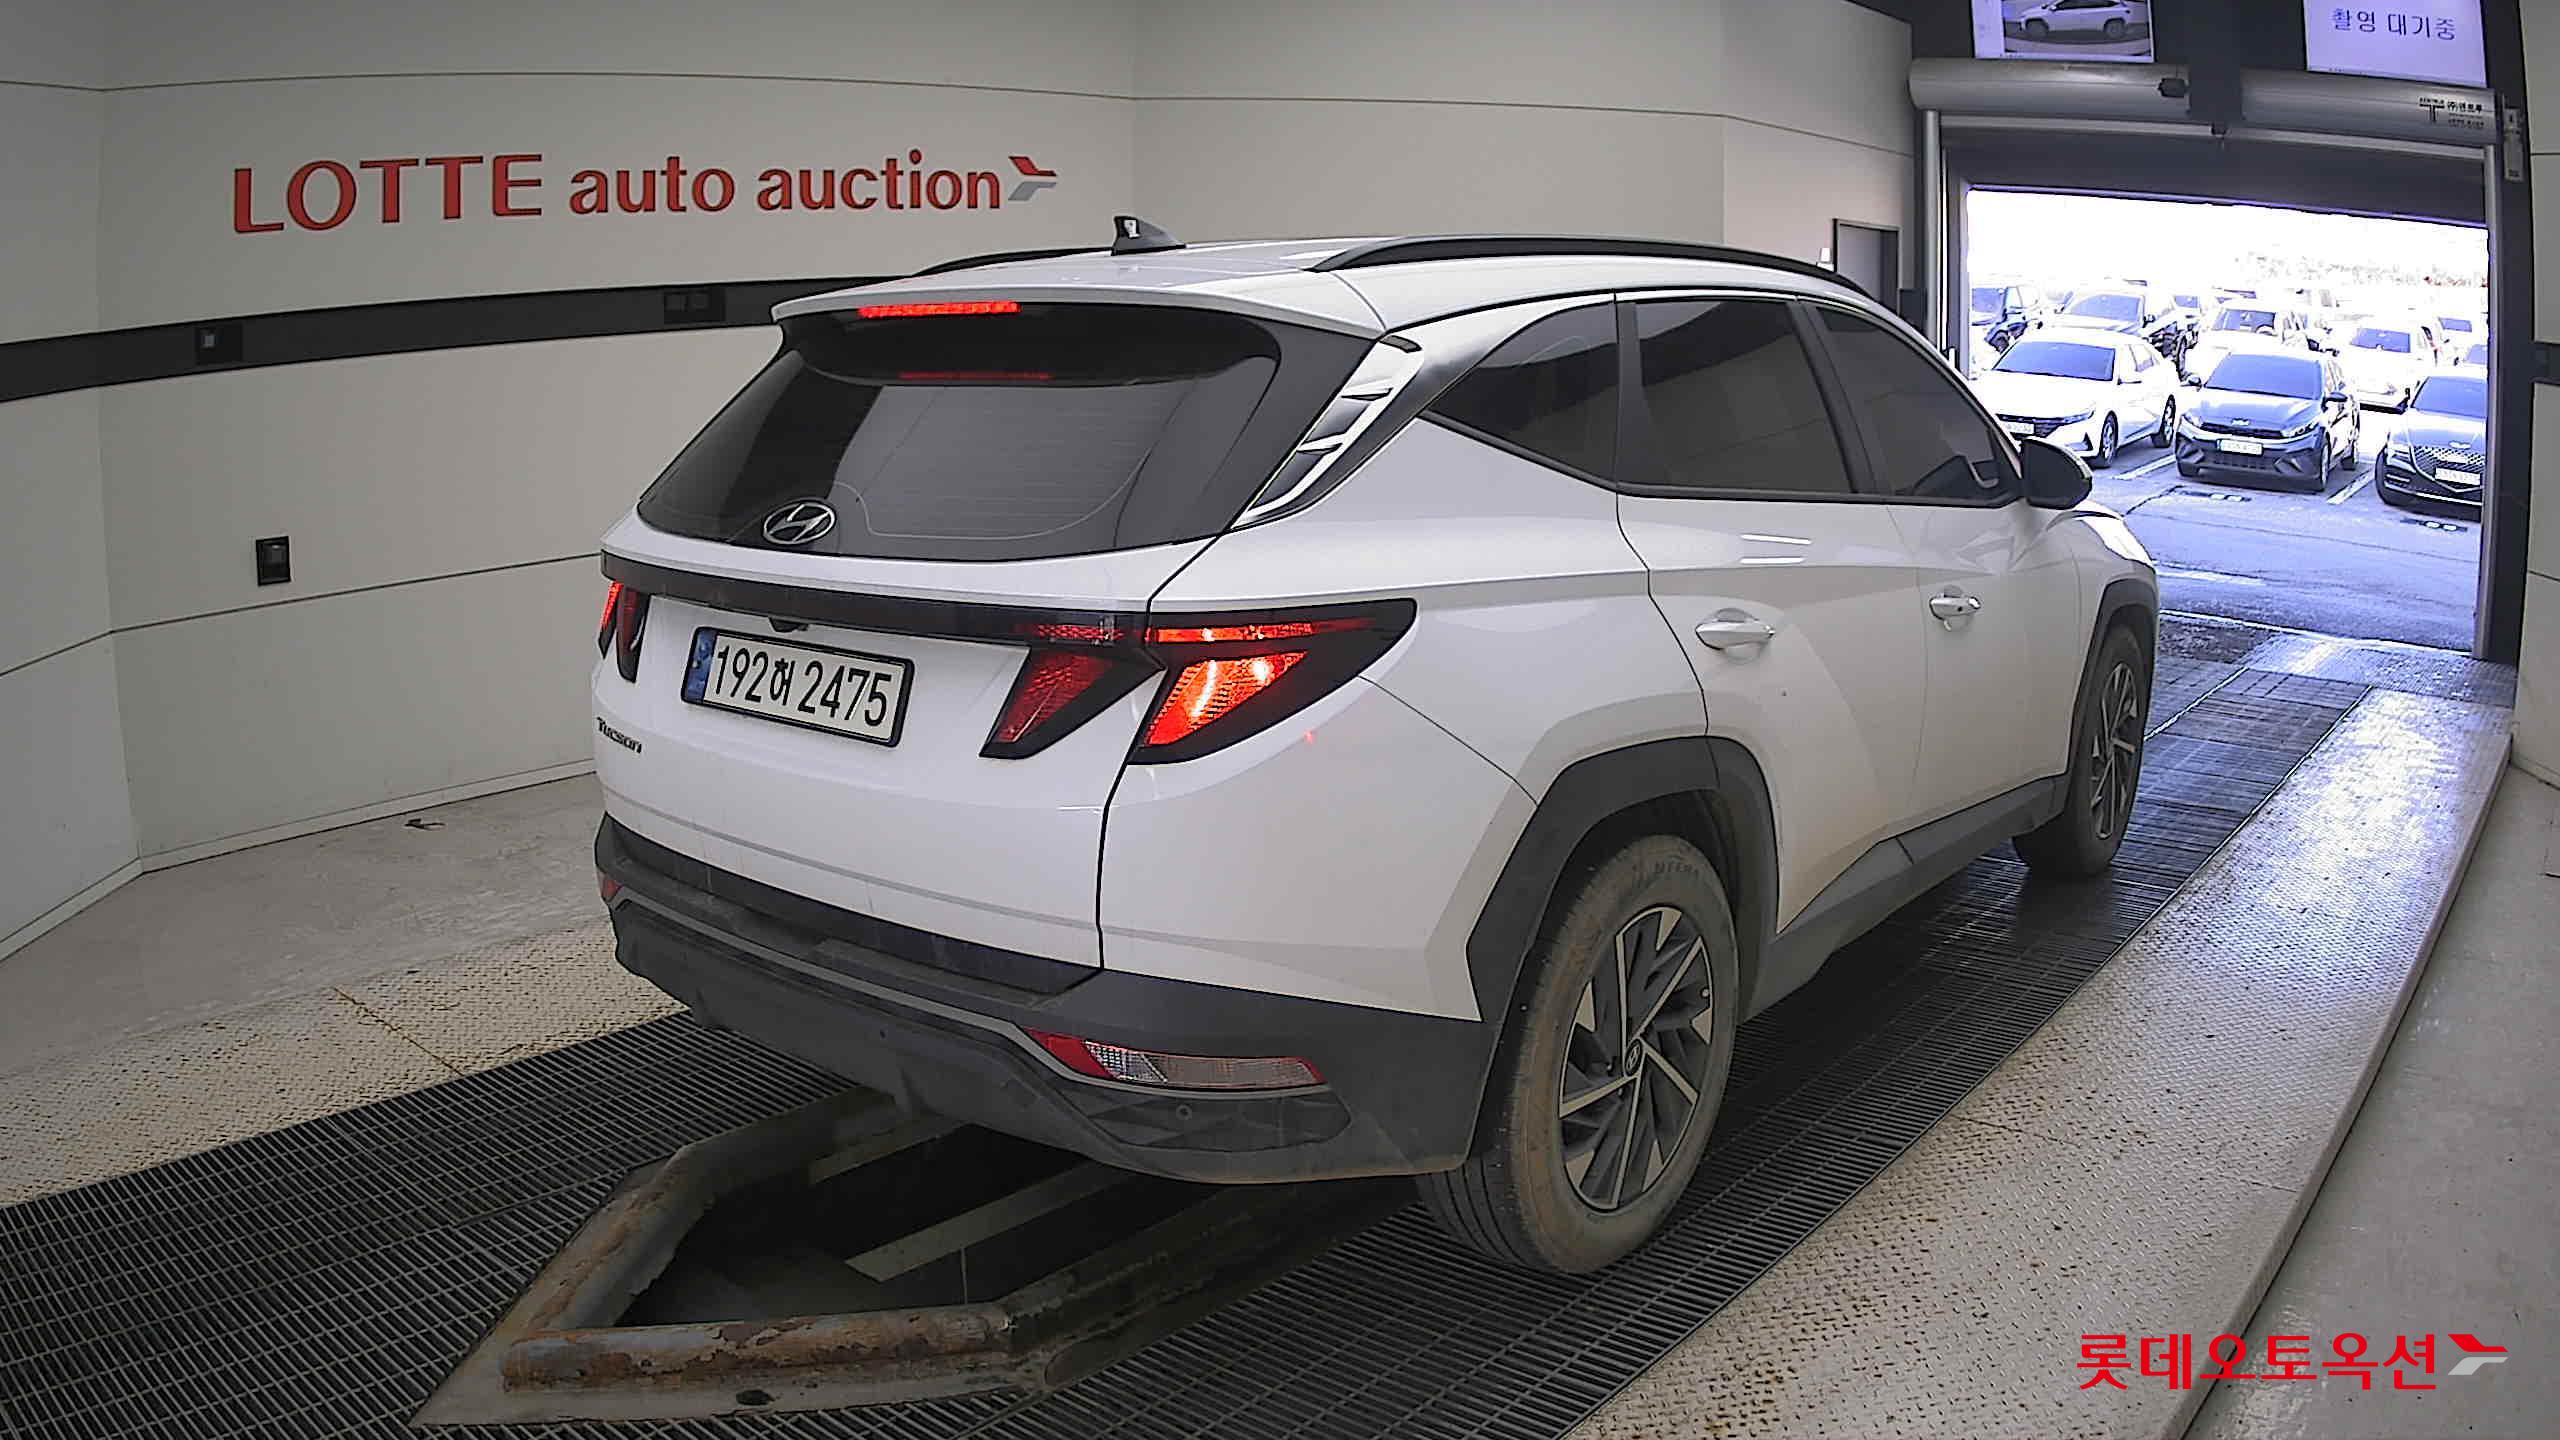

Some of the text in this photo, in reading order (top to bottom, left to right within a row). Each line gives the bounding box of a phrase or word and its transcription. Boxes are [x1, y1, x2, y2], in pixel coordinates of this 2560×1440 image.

[2332, 8, 2456, 41] 촬영 대기중
[233, 147, 1002, 235] LOTTE auto auction
[714, 644, 893, 727] 192허 2475
